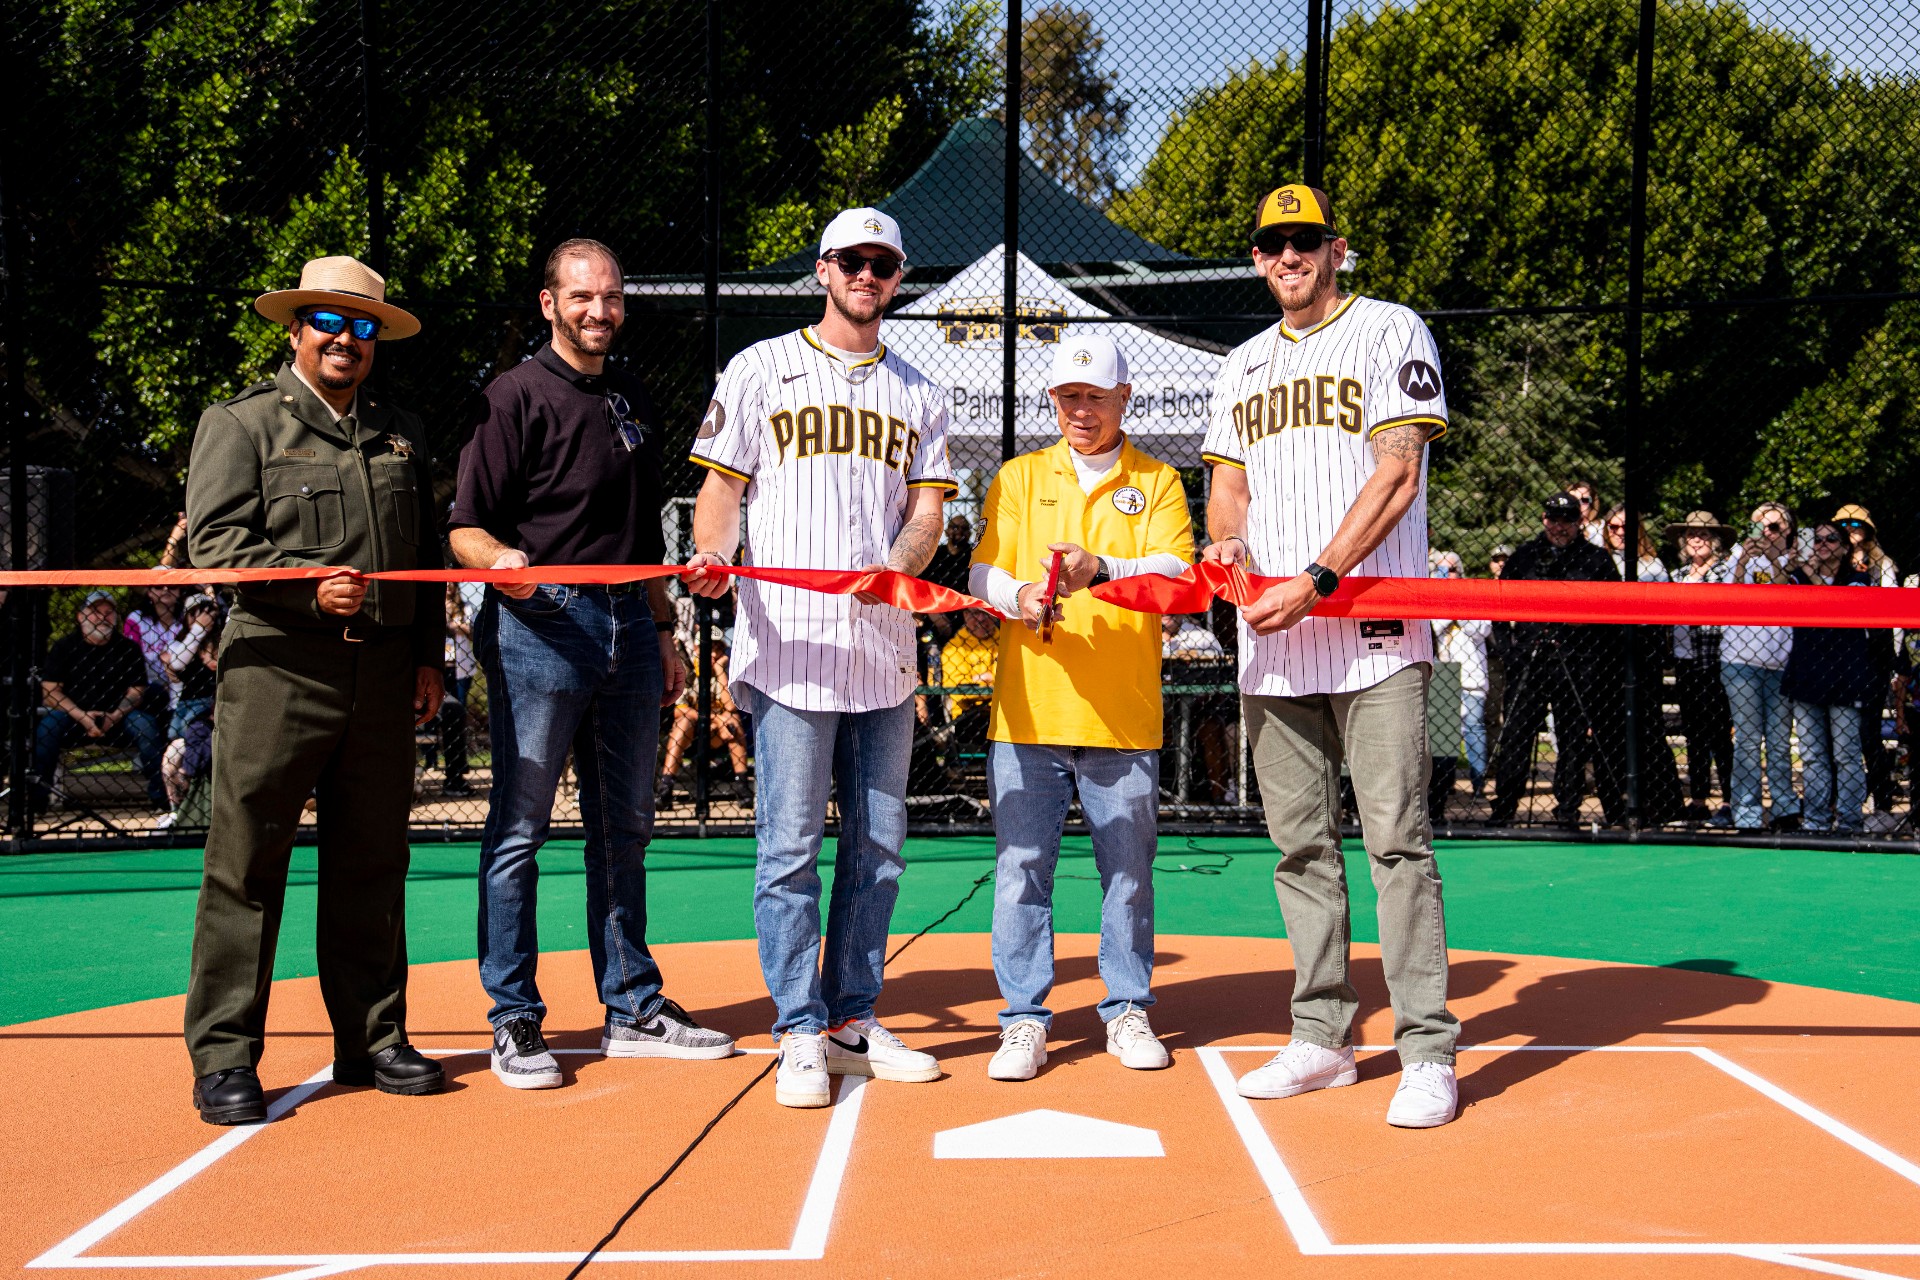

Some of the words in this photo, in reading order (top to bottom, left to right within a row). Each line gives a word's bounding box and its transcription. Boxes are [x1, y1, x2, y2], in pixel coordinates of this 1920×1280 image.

[966, 322, 1038, 340] PAK
[1163, 386, 1213, 418] Boot
[1231, 375, 1363, 453] PADRES
[769, 404, 920, 480] PADRES
